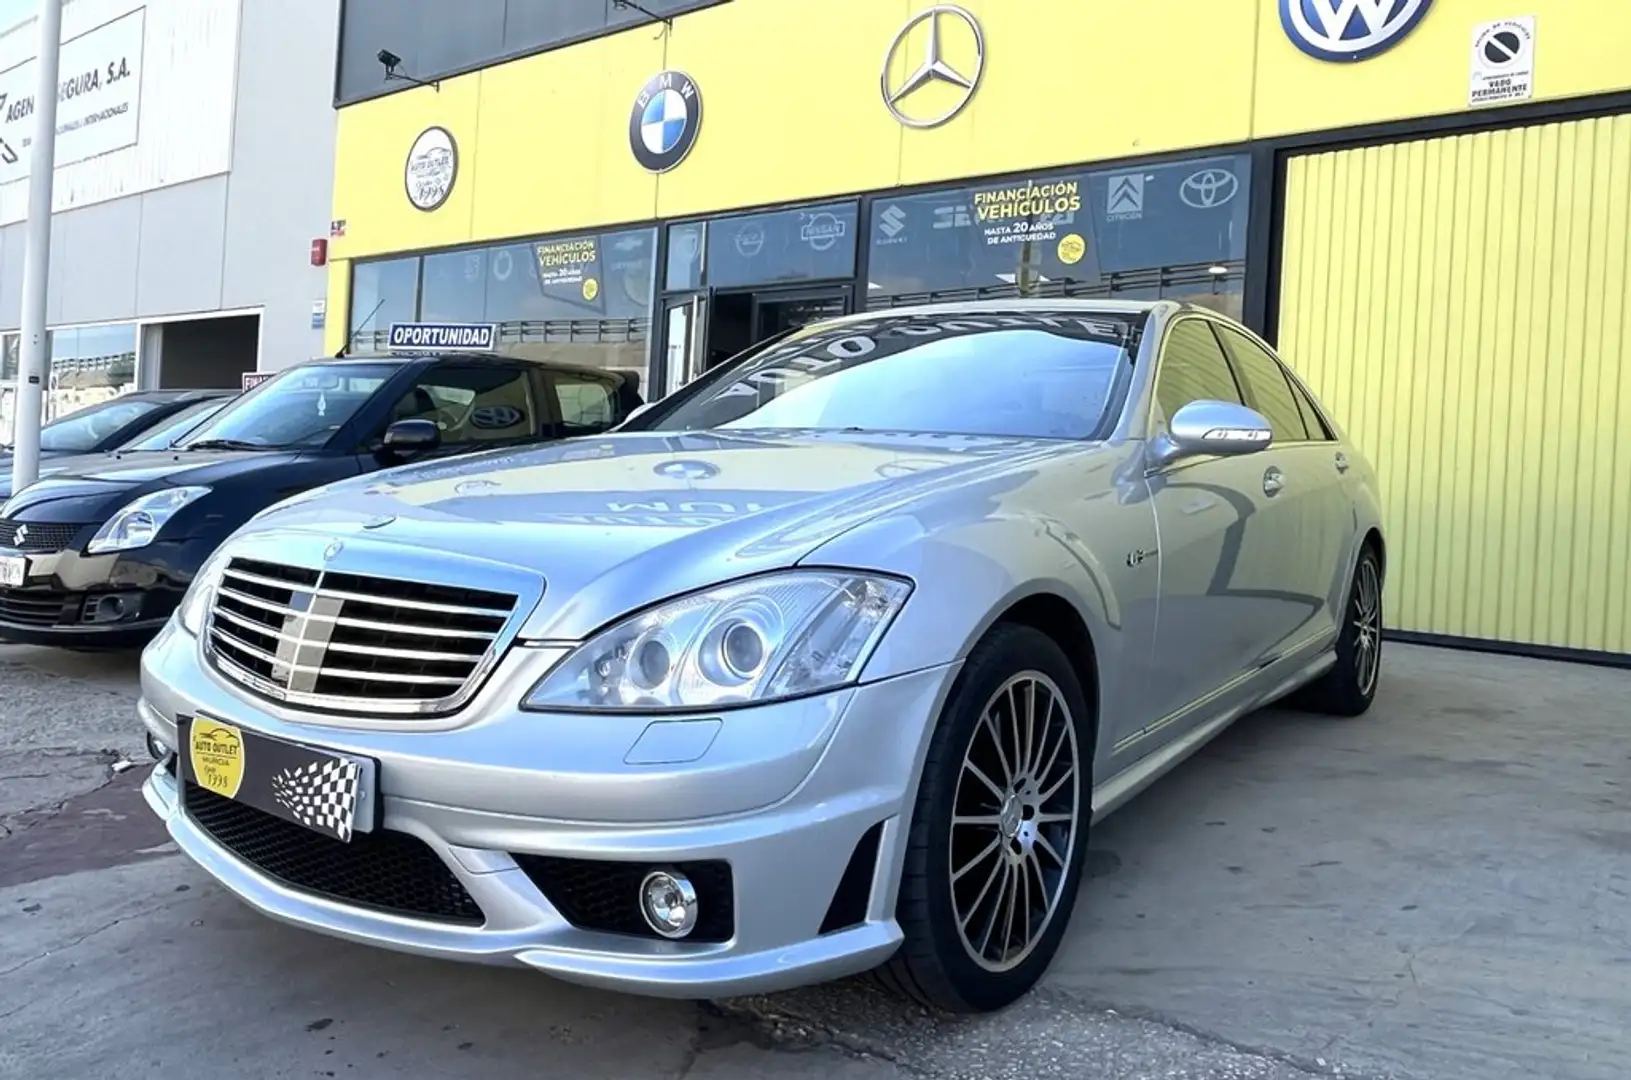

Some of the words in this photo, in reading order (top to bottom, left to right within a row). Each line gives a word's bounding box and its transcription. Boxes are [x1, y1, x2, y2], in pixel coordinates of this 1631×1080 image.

[5, 95, 34, 123] AGEN
[106, 57, 130, 84] S.A.
[974, 181, 1078, 204] FINANCIACIÓN
[977, 196, 1081, 221] VEHÍCULOS
[984, 226, 1011, 236] HASTA
[1013, 222, 1028, 232] 20
[1029, 222, 1054, 232] AÑOS
[987, 236, 998, 245] DE
[394, 327, 489, 345] OPORTUNIDAD
[195, 741, 211, 752] AUTO
[213, 743, 237, 755] OUTLET
